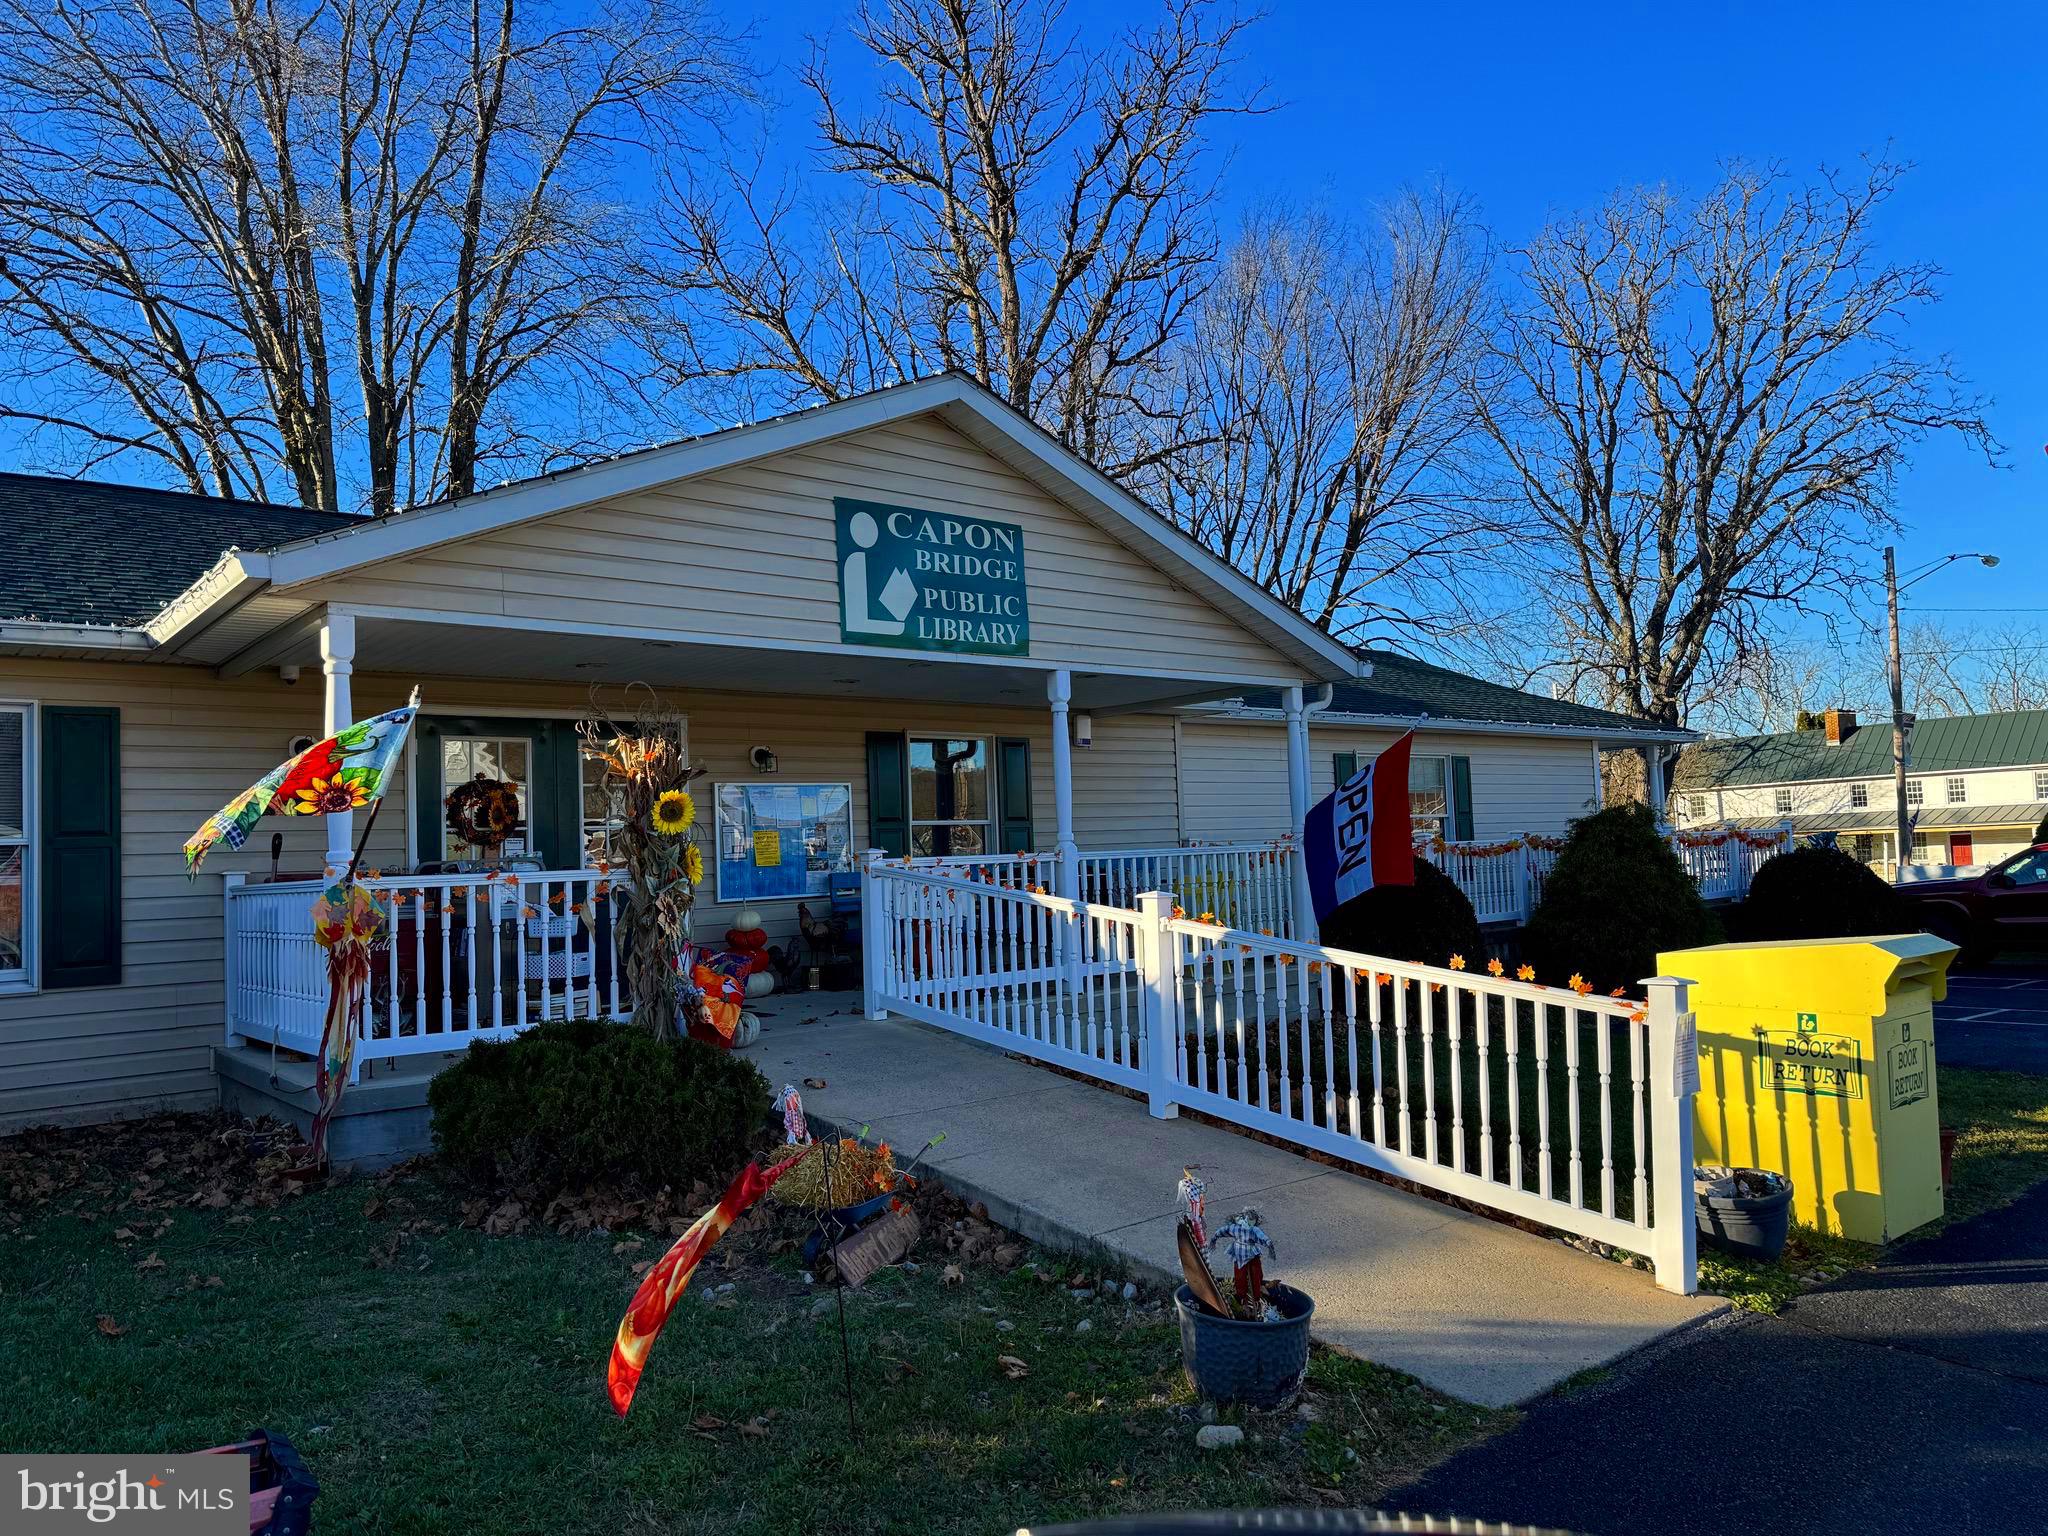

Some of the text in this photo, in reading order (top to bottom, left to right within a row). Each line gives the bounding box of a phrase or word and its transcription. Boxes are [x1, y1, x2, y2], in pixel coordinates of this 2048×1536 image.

[887, 512, 1015, 554] CAPON
[914, 548, 1018, 581] BRIDGE
[923, 587, 1021, 617] PUBLIC
[916, 615, 1021, 646] LIBRARY
[1337, 764, 1370, 880] OPEN
[1784, 1038, 1835, 1060] BOOK
[1898, 1047, 1918, 1070] BOOK
[1773, 1062, 1850, 1087] RETURN
[1894, 1071, 1923, 1097] RETURN
